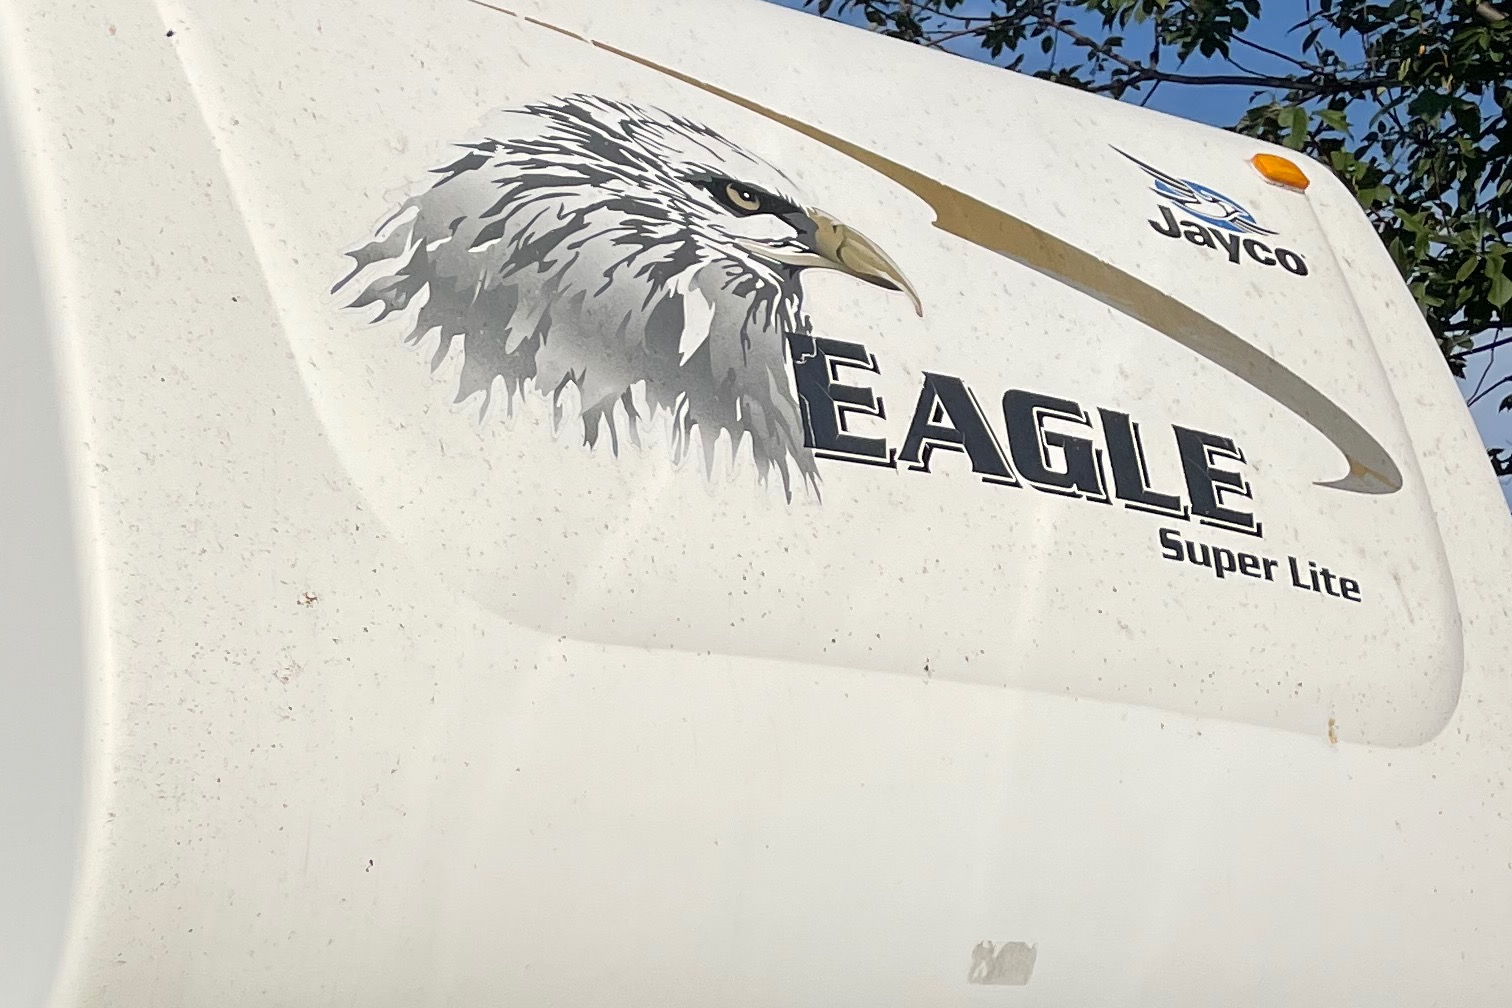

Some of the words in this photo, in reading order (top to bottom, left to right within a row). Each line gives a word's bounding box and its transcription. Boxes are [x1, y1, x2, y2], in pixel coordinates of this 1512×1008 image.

[1148, 204, 1308, 276] Jayco
[787, 332, 1262, 537] EAGLE
[1159, 527, 1278, 581] Super
[1288, 555, 1361, 602] Lite
